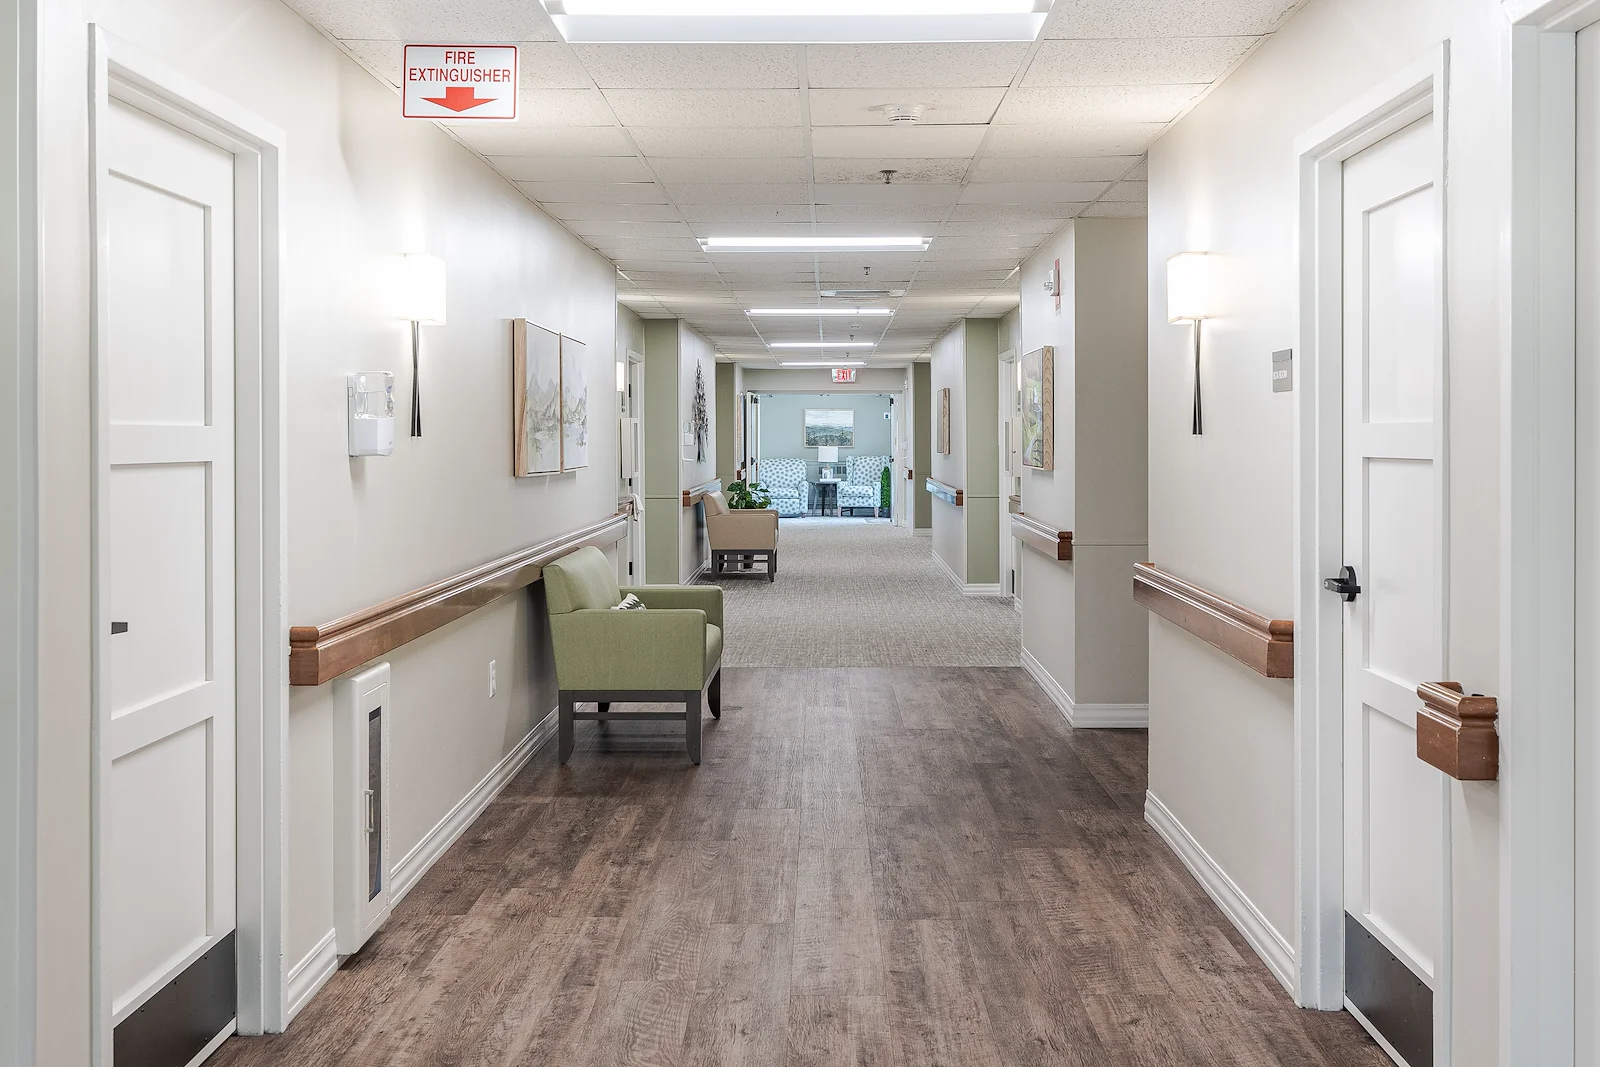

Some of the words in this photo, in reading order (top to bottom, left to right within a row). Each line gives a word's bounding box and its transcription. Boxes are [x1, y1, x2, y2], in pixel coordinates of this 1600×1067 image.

[445, 51, 476, 65] FIRE
[409, 67, 511, 83] EXTINGUISHER
[836, 368, 852, 381] EXIT
